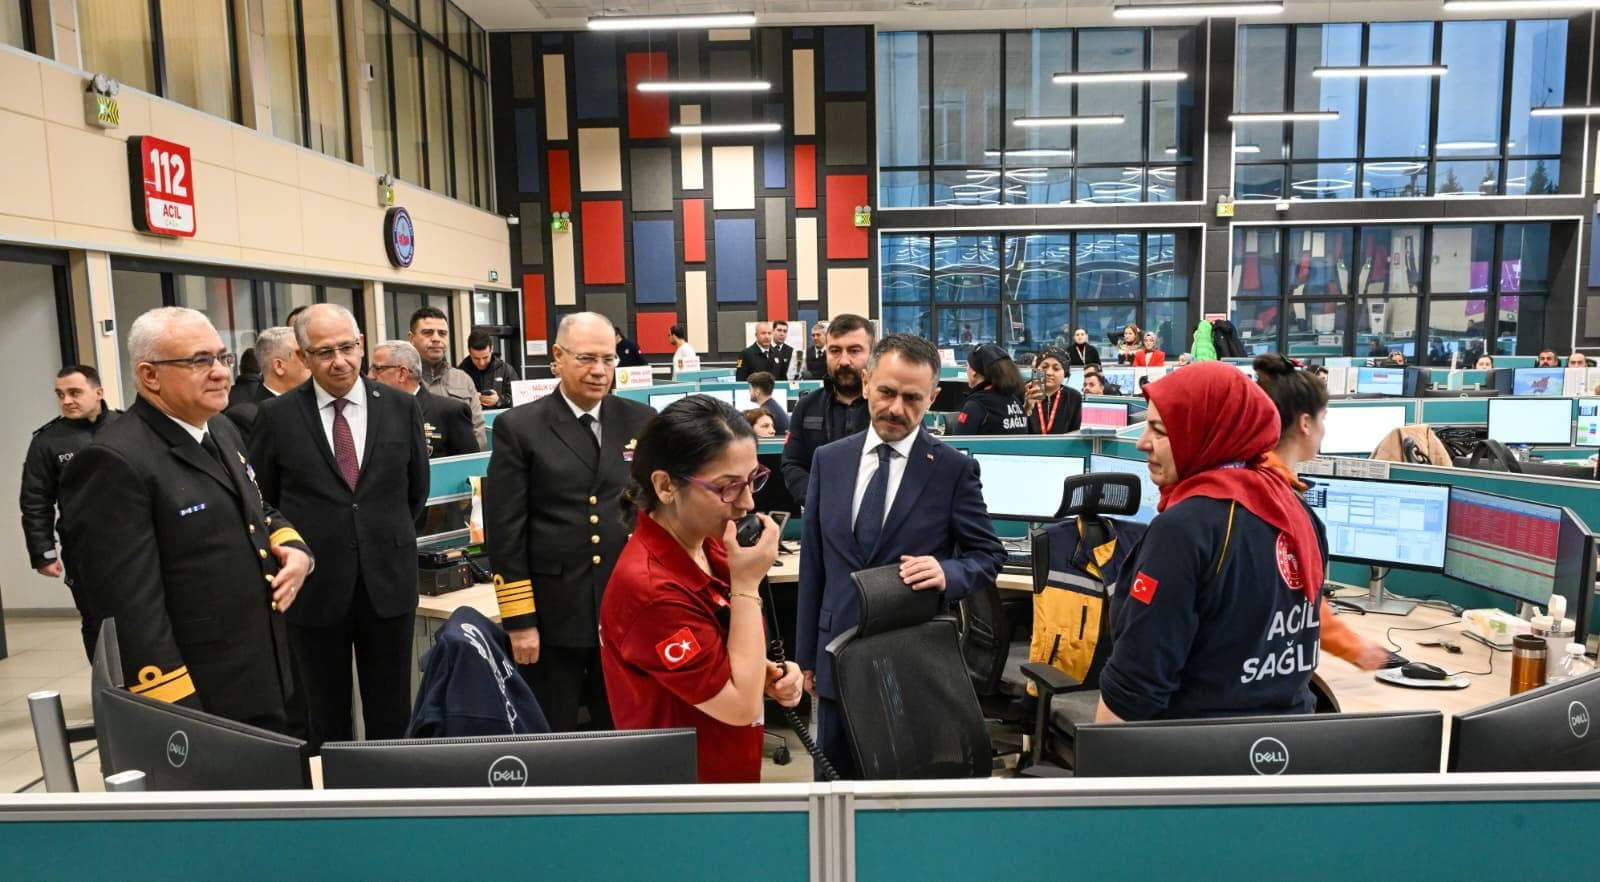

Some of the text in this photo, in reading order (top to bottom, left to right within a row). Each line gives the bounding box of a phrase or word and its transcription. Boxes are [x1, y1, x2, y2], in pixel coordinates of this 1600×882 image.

[150, 148, 188, 198] 112
[1003, 414, 1028, 430] SAĞLI
[58, 452, 74, 463] PO
[1267, 598, 1320, 641] ACİL
[1240, 638, 1321, 684] SAĞLI
[1571, 712, 1588, 727] DELL
[169, 742, 185, 756] DELL
[1255, 751, 1286, 763] DELL
[493, 770, 524, 781] DELL
